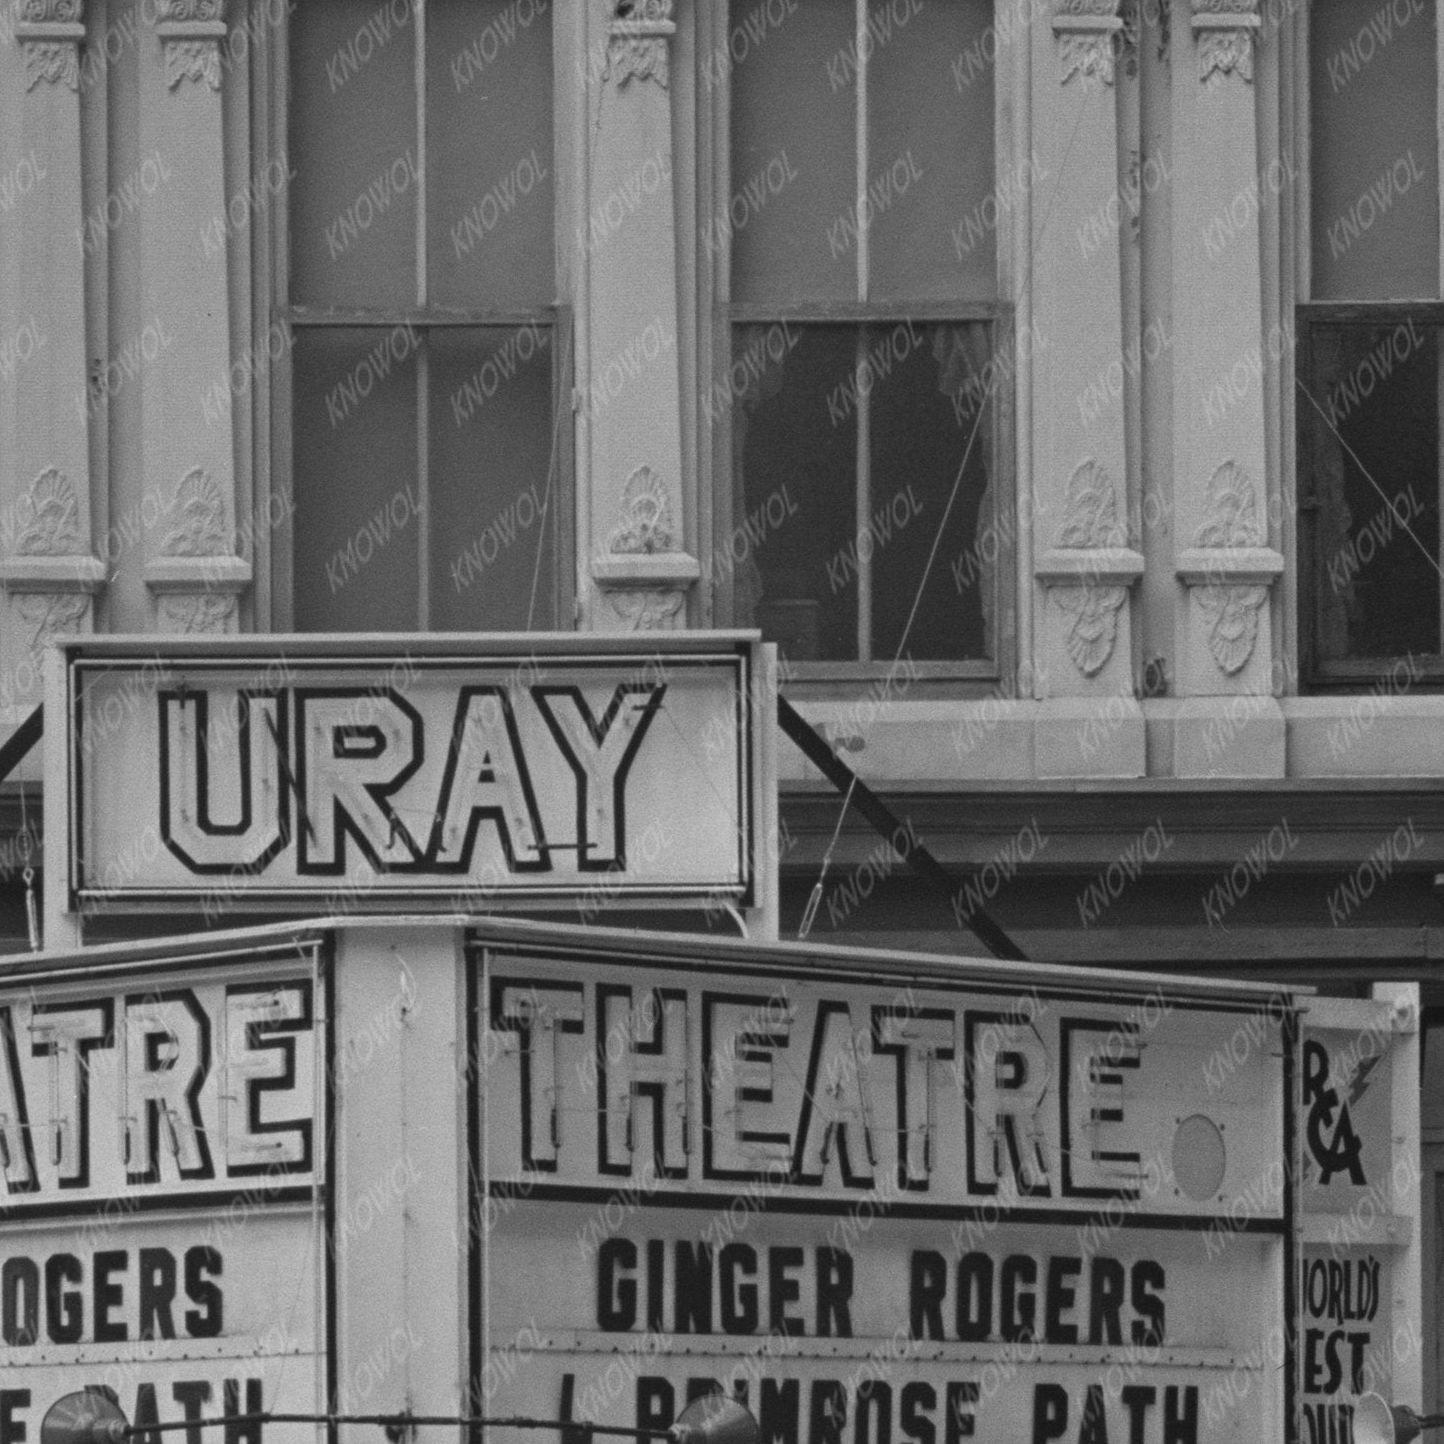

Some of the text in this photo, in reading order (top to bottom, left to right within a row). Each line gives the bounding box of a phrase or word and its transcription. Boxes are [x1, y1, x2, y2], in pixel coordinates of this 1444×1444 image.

[159, 684, 667, 877] URAY
[489, 976, 1141, 1197] THEATRE
[597, 1238, 1165, 1344] GINGER ROGERS
[1303, 1329, 1370, 1395] EST
